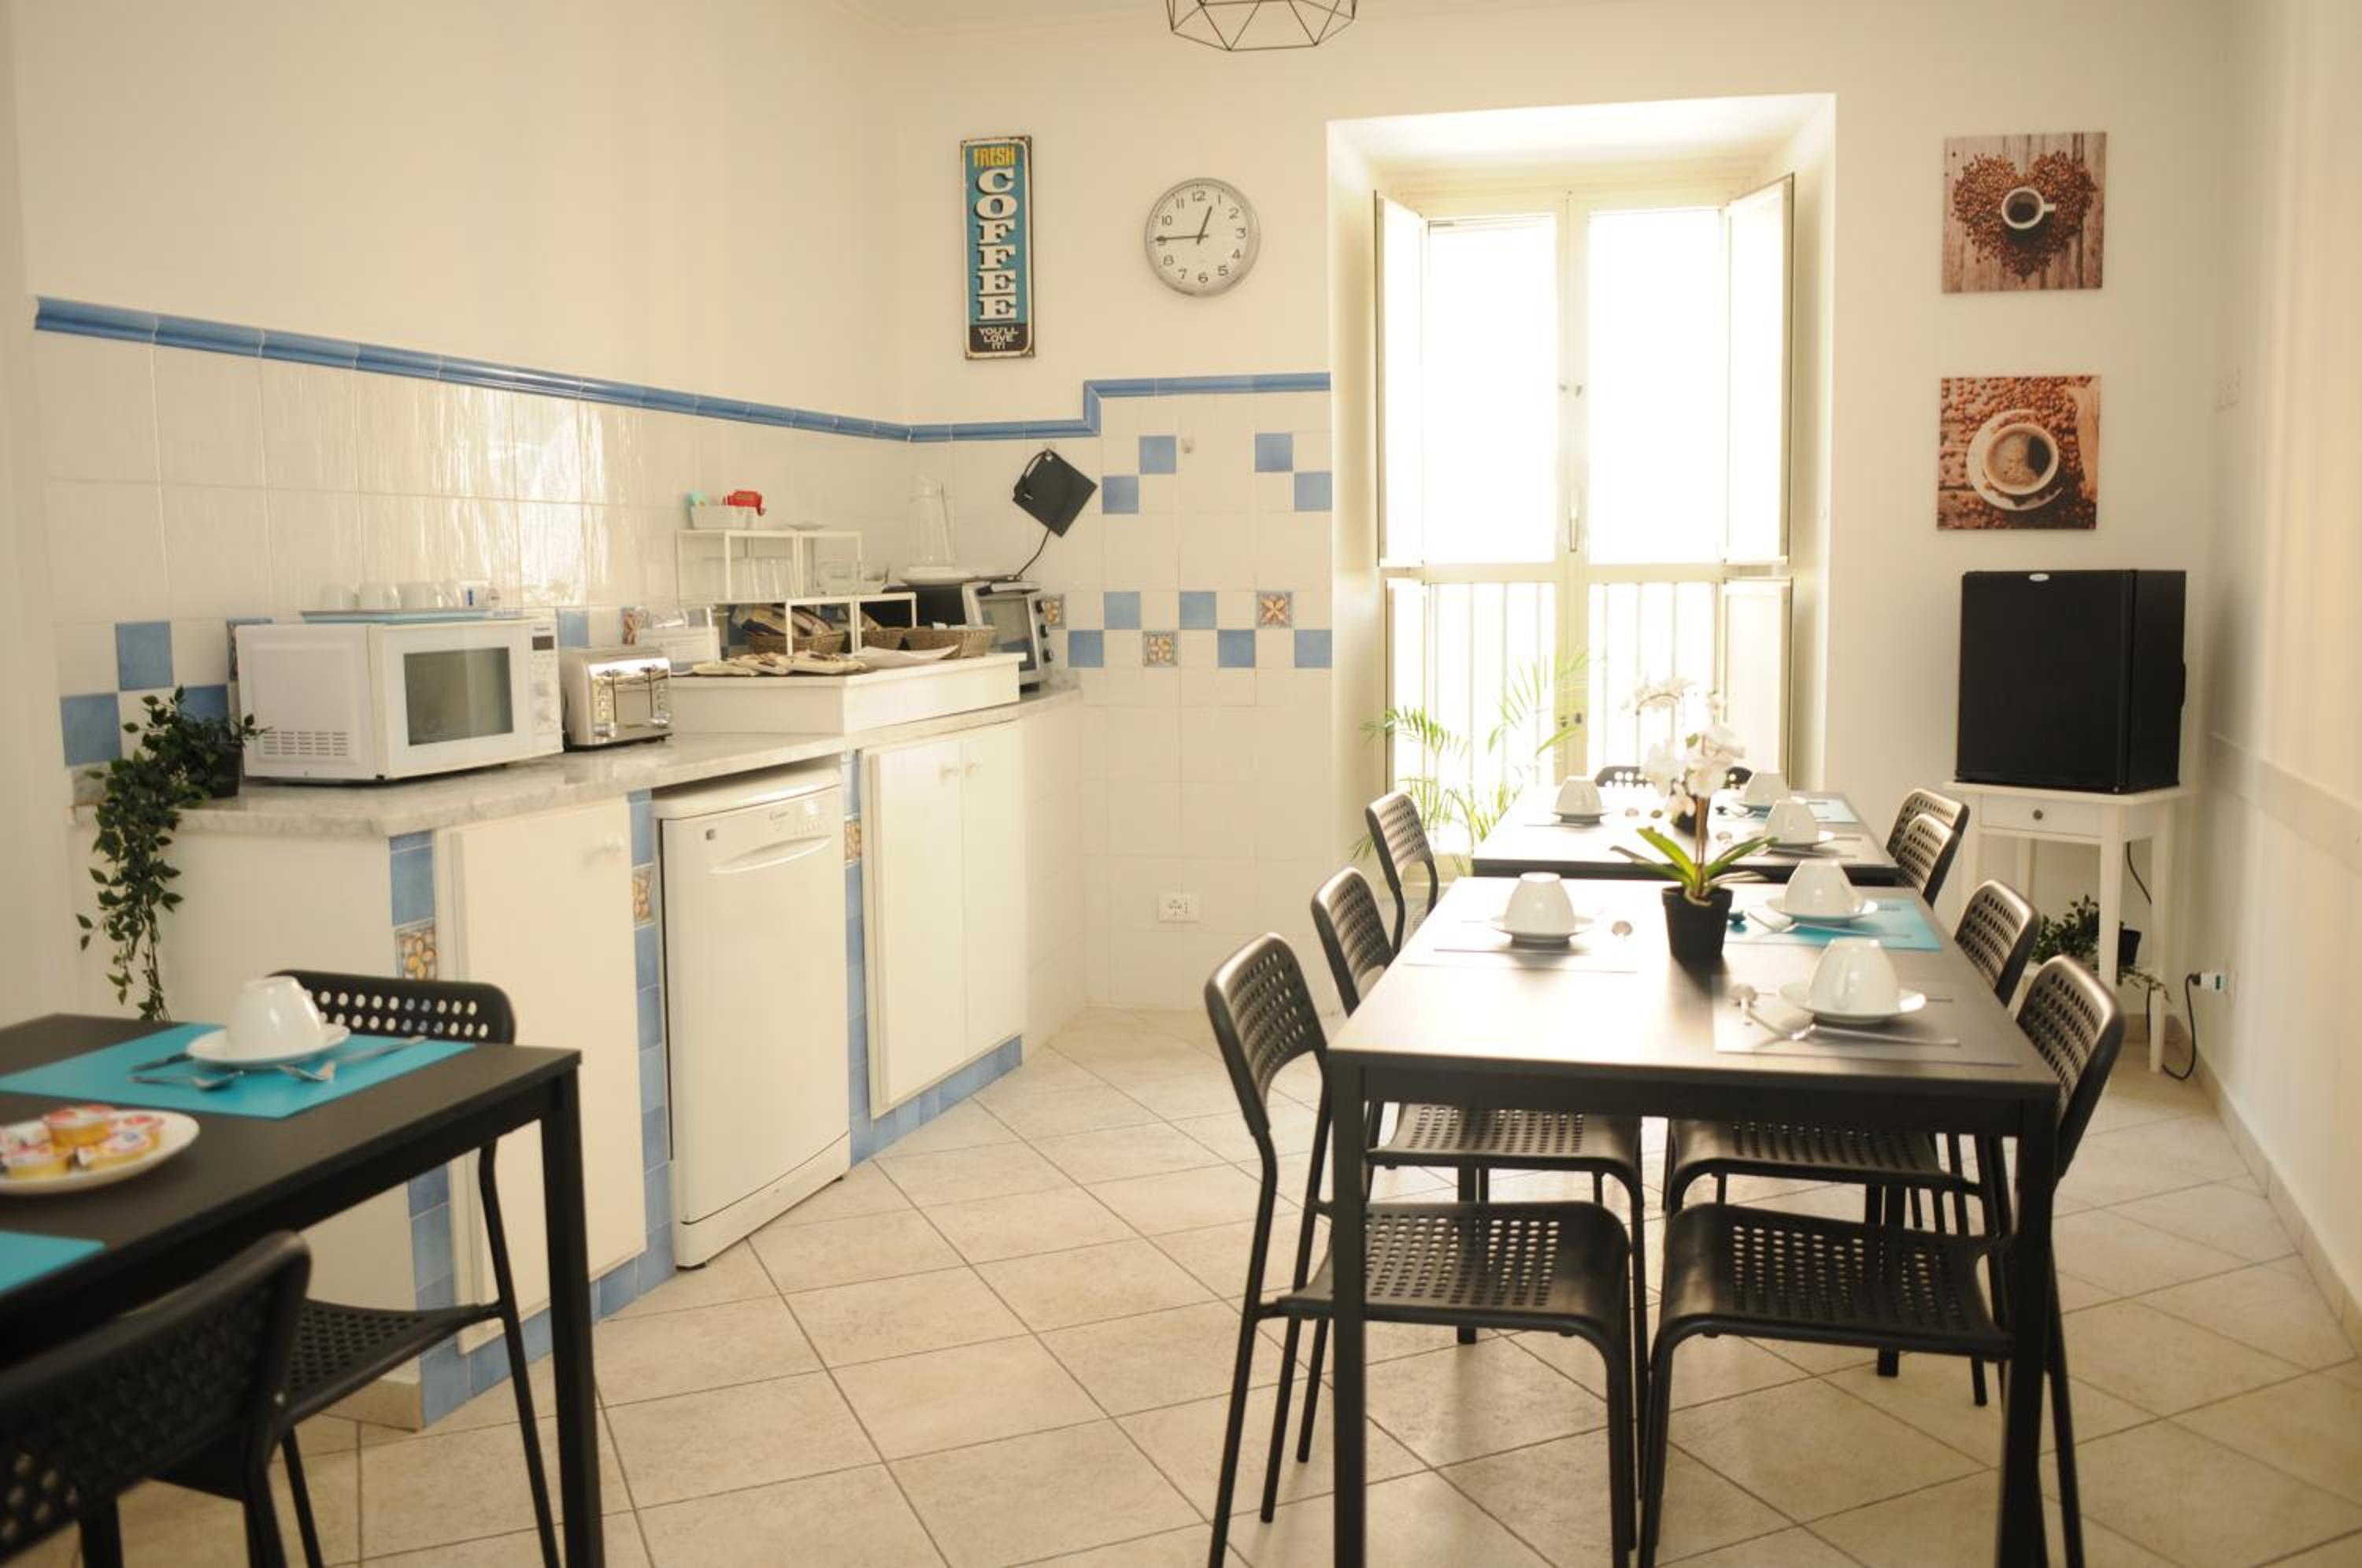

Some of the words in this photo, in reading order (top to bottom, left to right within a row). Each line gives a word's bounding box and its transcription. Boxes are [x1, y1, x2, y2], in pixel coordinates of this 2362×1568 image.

[974, 146, 1016, 168] FRESH
[1192, 190, 1206, 202] 12
[1217, 194, 1222, 206] 1
[1175, 198, 1185, 209] 11
[1228, 207, 1239, 220] 2
[1161, 215, 1172, 226] 10
[1235, 227, 1246, 239] 3
[975, 166, 1018, 322] COFFEE
[1163, 254, 1175, 266] 8
[1232, 249, 1241, 259] 4
[1178, 268, 1187, 279] 7
[1218, 264, 1229, 276] 5
[1198, 272, 1209, 283] 6
[979, 327, 1019, 336] YOU'LL
[983, 334, 1015, 343] LOVE
